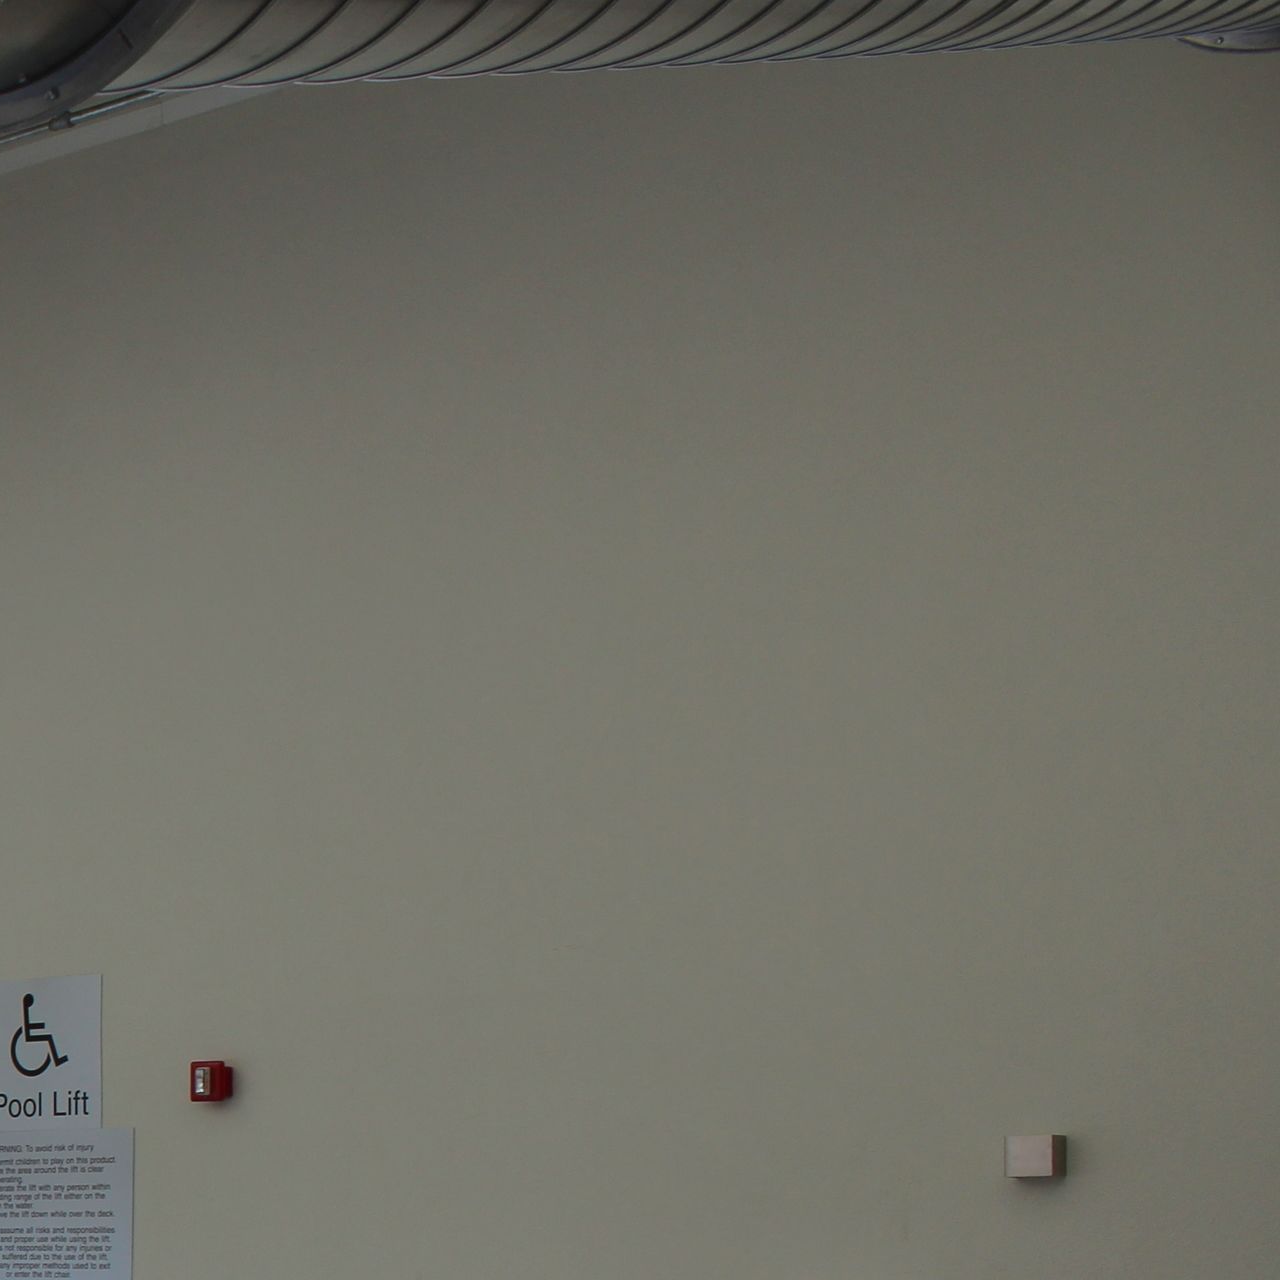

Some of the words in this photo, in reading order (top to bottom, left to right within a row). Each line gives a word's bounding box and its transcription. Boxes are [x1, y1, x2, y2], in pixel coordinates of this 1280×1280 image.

[53, 1090, 89, 1116] Lift
[35, 1144, 52, 1152] avoid
[16, 1157, 40, 1165] children
[50, 1157, 64, 1166] play
[6, 1166, 16, 1174] the
[34, 1166, 56, 1174] around
[53, 1185, 65, 1193] any
[67, 1185, 89, 1193] person
[92, 1183, 111, 1191] within
[14, 1194, 32, 1202] range
[54, 1192, 62, 1200] lift
[64, 1192, 82, 1200] either
[95, 1192, 106, 1200] the
[85, 1210, 95, 1218] the
[26, 1226, 34, 1234] all
[36, 1226, 50, 1234] risks
[52, 1226, 65, 1234] and
[67, 1227, 115, 1236] responsibilities
[14, 1236, 34, 1244] proper
[51, 1235, 67, 1243] while
[69, 1235, 87, 1245] using
